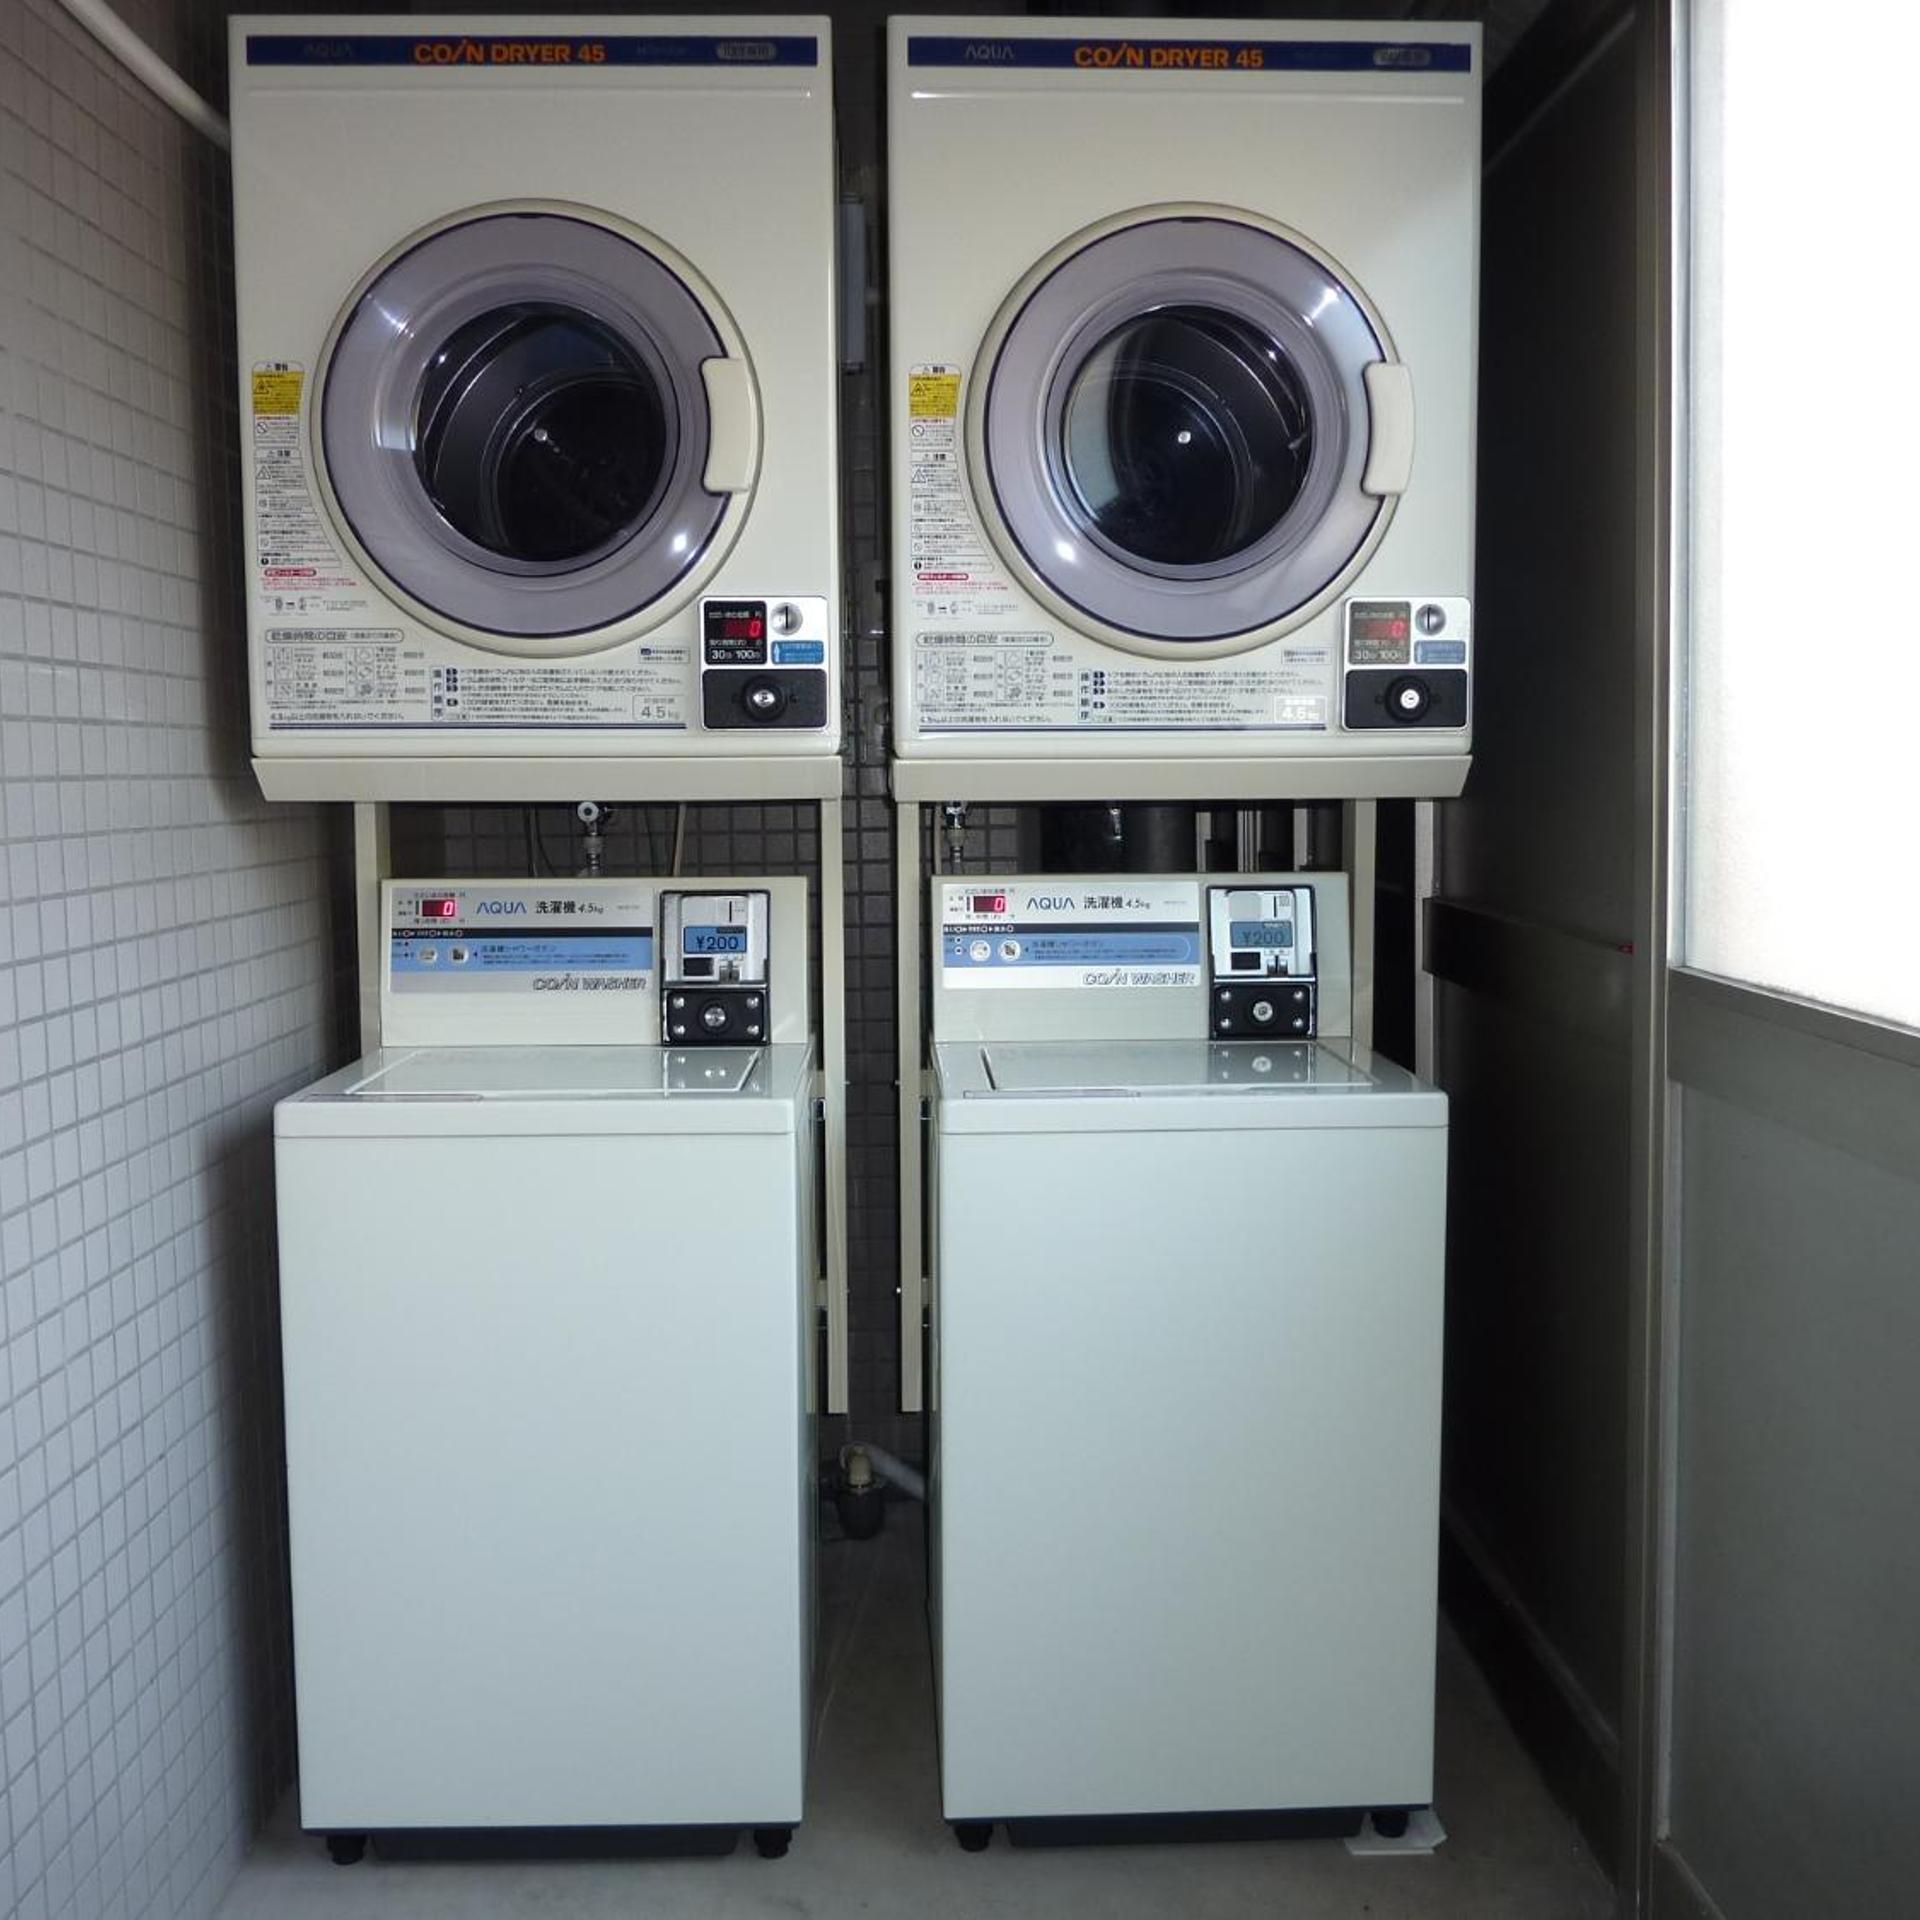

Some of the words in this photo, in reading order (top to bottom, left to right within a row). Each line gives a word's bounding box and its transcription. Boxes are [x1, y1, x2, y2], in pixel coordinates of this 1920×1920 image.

[490, 43, 571, 62] DRYER
[576, 43, 606, 62] 45
[965, 43, 1015, 60] AQUA
[1150, 47, 1230, 67] DRYER
[1235, 49, 1264, 68] 45
[749, 620, 762, 637] 0
[442, 901, 455, 916] 0
[476, 901, 527, 915] AQUA
[535, 901, 576, 914] 洗濯機
[993, 897, 1005, 912] 0
[1026, 897, 1076, 910] AQUA
[1083, 896, 1123, 910] 洗濯機
[696, 936, 739, 950] ¥200
[581, 976, 647, 991] WASHER
[1130, 971, 1196, 986] WASHER
